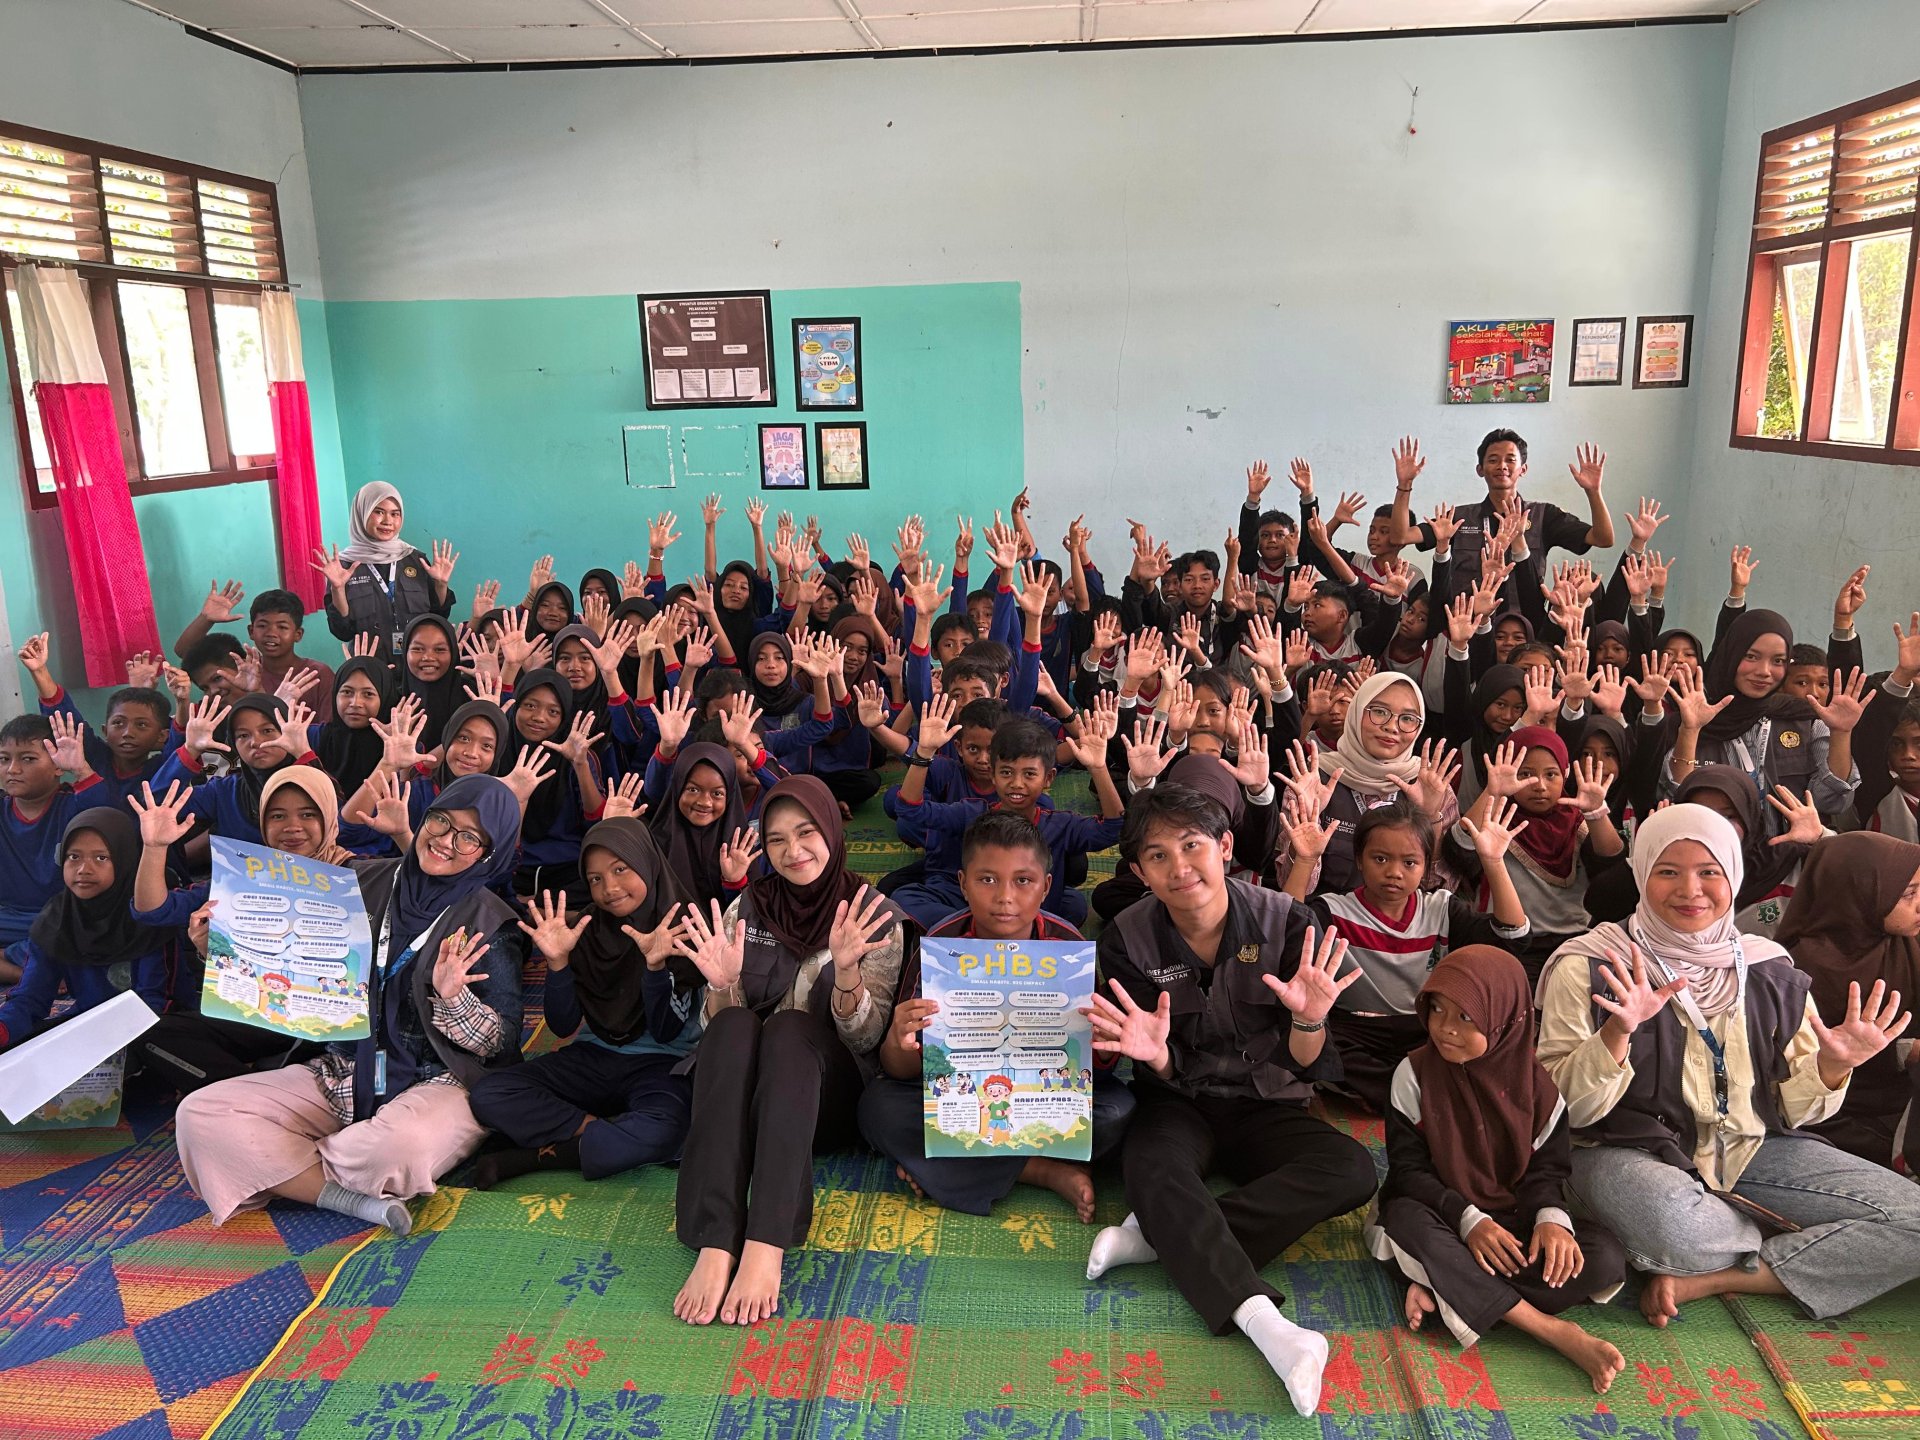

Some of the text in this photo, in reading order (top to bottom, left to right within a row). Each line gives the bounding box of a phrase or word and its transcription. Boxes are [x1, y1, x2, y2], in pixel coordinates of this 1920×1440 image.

[1456, 322, 1548, 332] AKU SEHAT
[1584, 324, 1615, 335] STOP
[772, 432, 794, 441] JAGA
[245, 856, 332, 892] PHBS
[746, 936, 776, 946] EKRETARIS
[958, 953, 1058, 979] PHBS
[1154, 972, 1188, 984] ESEHATAN
